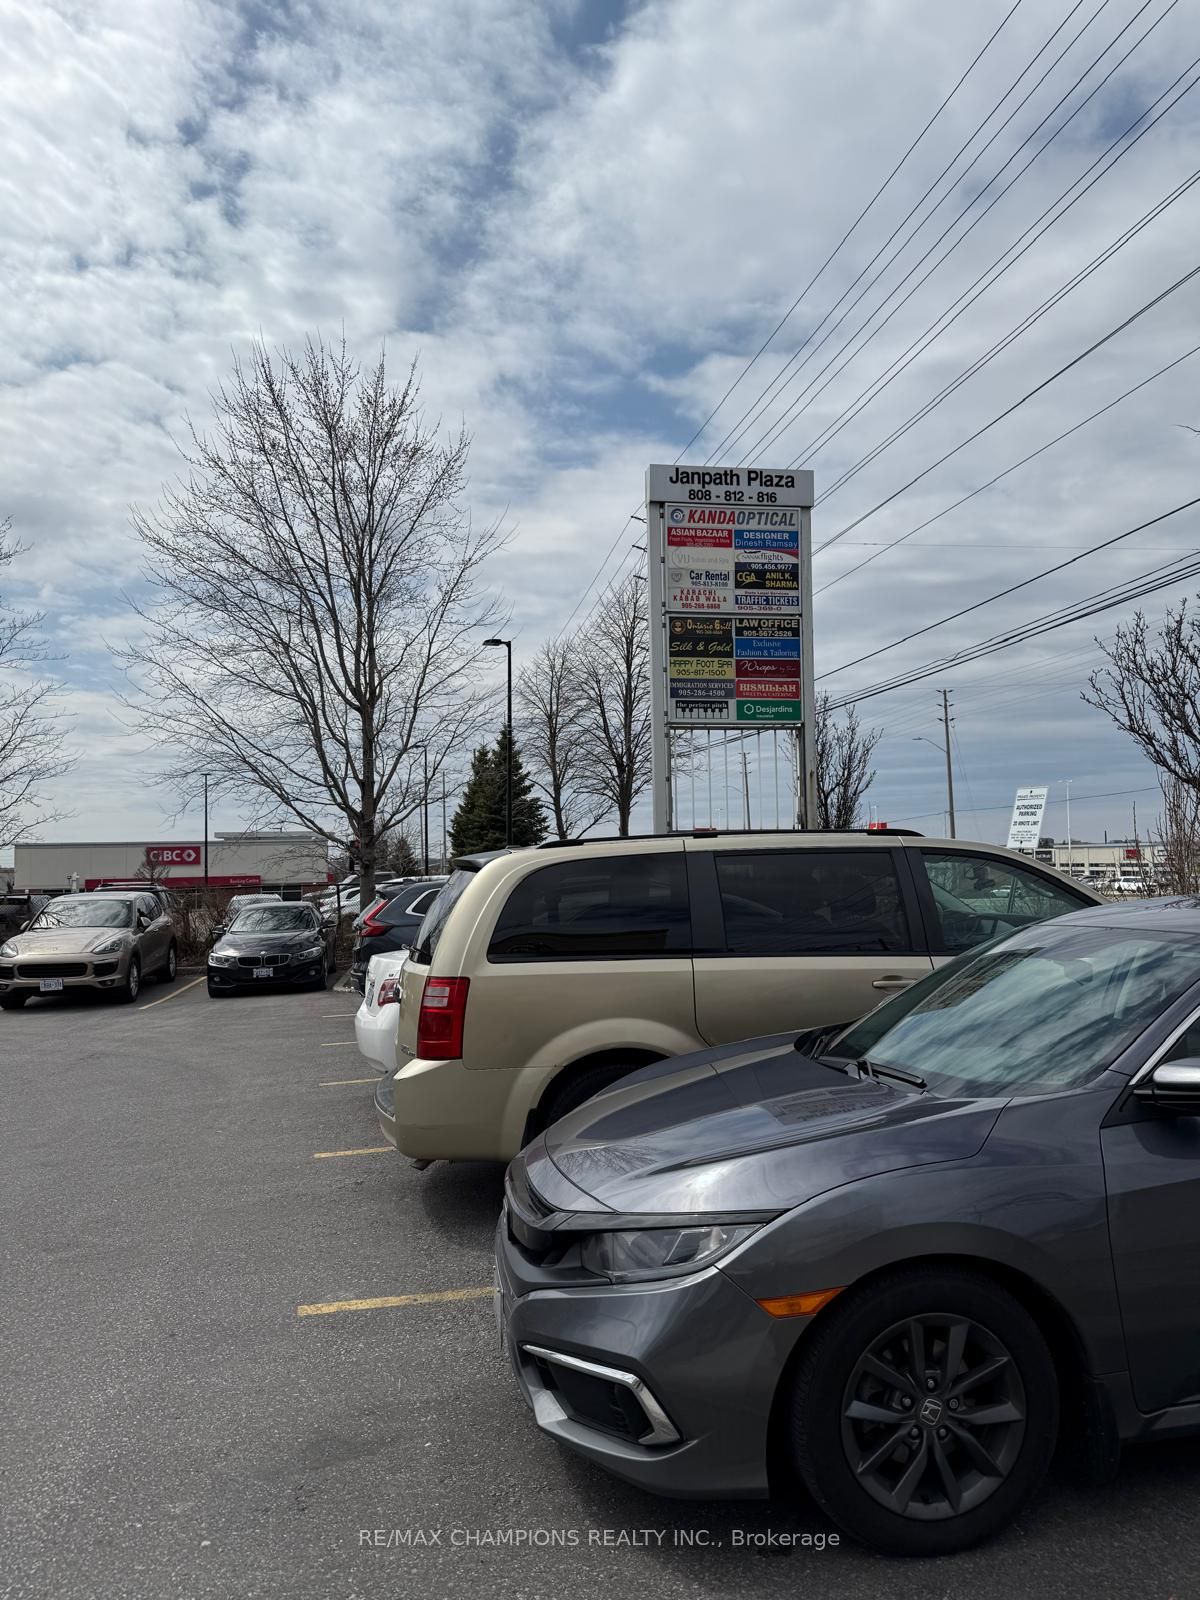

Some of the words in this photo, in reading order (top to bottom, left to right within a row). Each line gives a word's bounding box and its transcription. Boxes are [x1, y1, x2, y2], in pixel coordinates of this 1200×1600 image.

[669, 467, 740, 489] Janpath
[747, 469, 795, 488] Plaza
[688, 489, 712, 501] 808
[724, 490, 744, 502] 812
[757, 491, 777, 503] 816
[671, 528, 695, 537] ASIAN
[696, 529, 729, 538] BAZAAR
[743, 531, 790, 540] DESIGNER
[735, 538, 763, 547] Dinesh
[765, 539, 798, 550] Ramsay
[689, 570, 703, 581] Car
[705, 570, 730, 582] Rental
[736, 571, 757, 582] CGA
[765, 571, 784, 580] ANIL
[765, 580, 798, 588] SHARMA
[705, 595, 728, 603] WALA
[736, 595, 767, 606] TRAFFIC
[768, 596, 798, 606] TICKETS
[687, 619, 714, 631] Ontario
[714, 619, 732, 630] Grill
[736, 619, 760, 628] LAW
[760, 619, 798, 628] OFFICE
[670, 641, 693, 651] Silk
[696, 641, 705, 651] &
[708, 641, 732, 654] Gold
[752, 639, 782, 648] Exclusive
[737, 648, 762, 657] Fashion
[763, 649, 769, 657] &
[770, 649, 798, 659] Tailoring
[670, 659, 694, 669] HAPPY
[696, 659, 715, 669] FOOT
[717, 660, 733, 669] SPA
[740, 660, 778, 675] Wraps
[676, 669, 727, 677] 905-817-1500
[708, 682, 734, 690] SERVICES
[739, 683, 796, 693] BISMILLAH
[712, 702, 728, 710] pitch
[755, 705, 794, 714] Desjardins
[150, 850, 182, 861] CIBC
